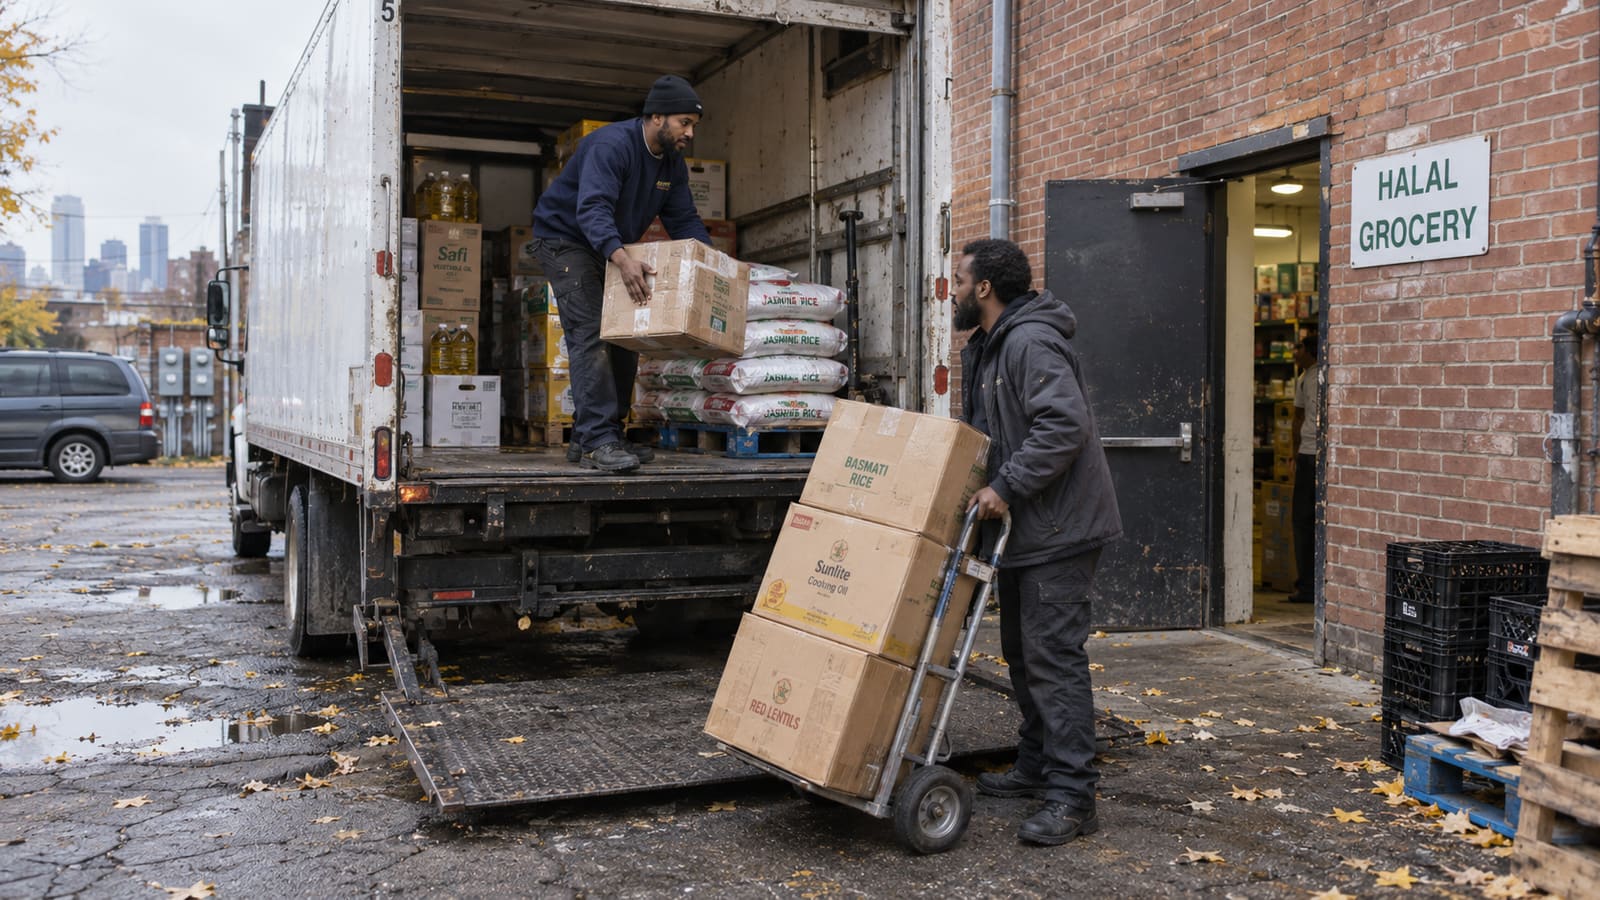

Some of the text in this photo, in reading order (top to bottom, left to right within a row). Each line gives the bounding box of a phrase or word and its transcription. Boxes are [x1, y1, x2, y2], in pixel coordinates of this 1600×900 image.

[381, 0, 395, 22] 5
[1378, 158, 1458, 201] HALAL
[1360, 205, 1477, 252] GROCERY
[438, 246, 468, 263] Safi
[801, 335, 820, 345] RICE
[802, 408, 822, 418] RICE
[844, 456, 889, 477] BASMATI
[849, 472, 874, 489] RICE
[815, 559, 851, 581] Sunlite
[807, 575, 837, 594] Cooking
[837, 584, 849, 596] Oil
[749, 698, 767, 716] RED
[766, 706, 801, 730] LENTILS
